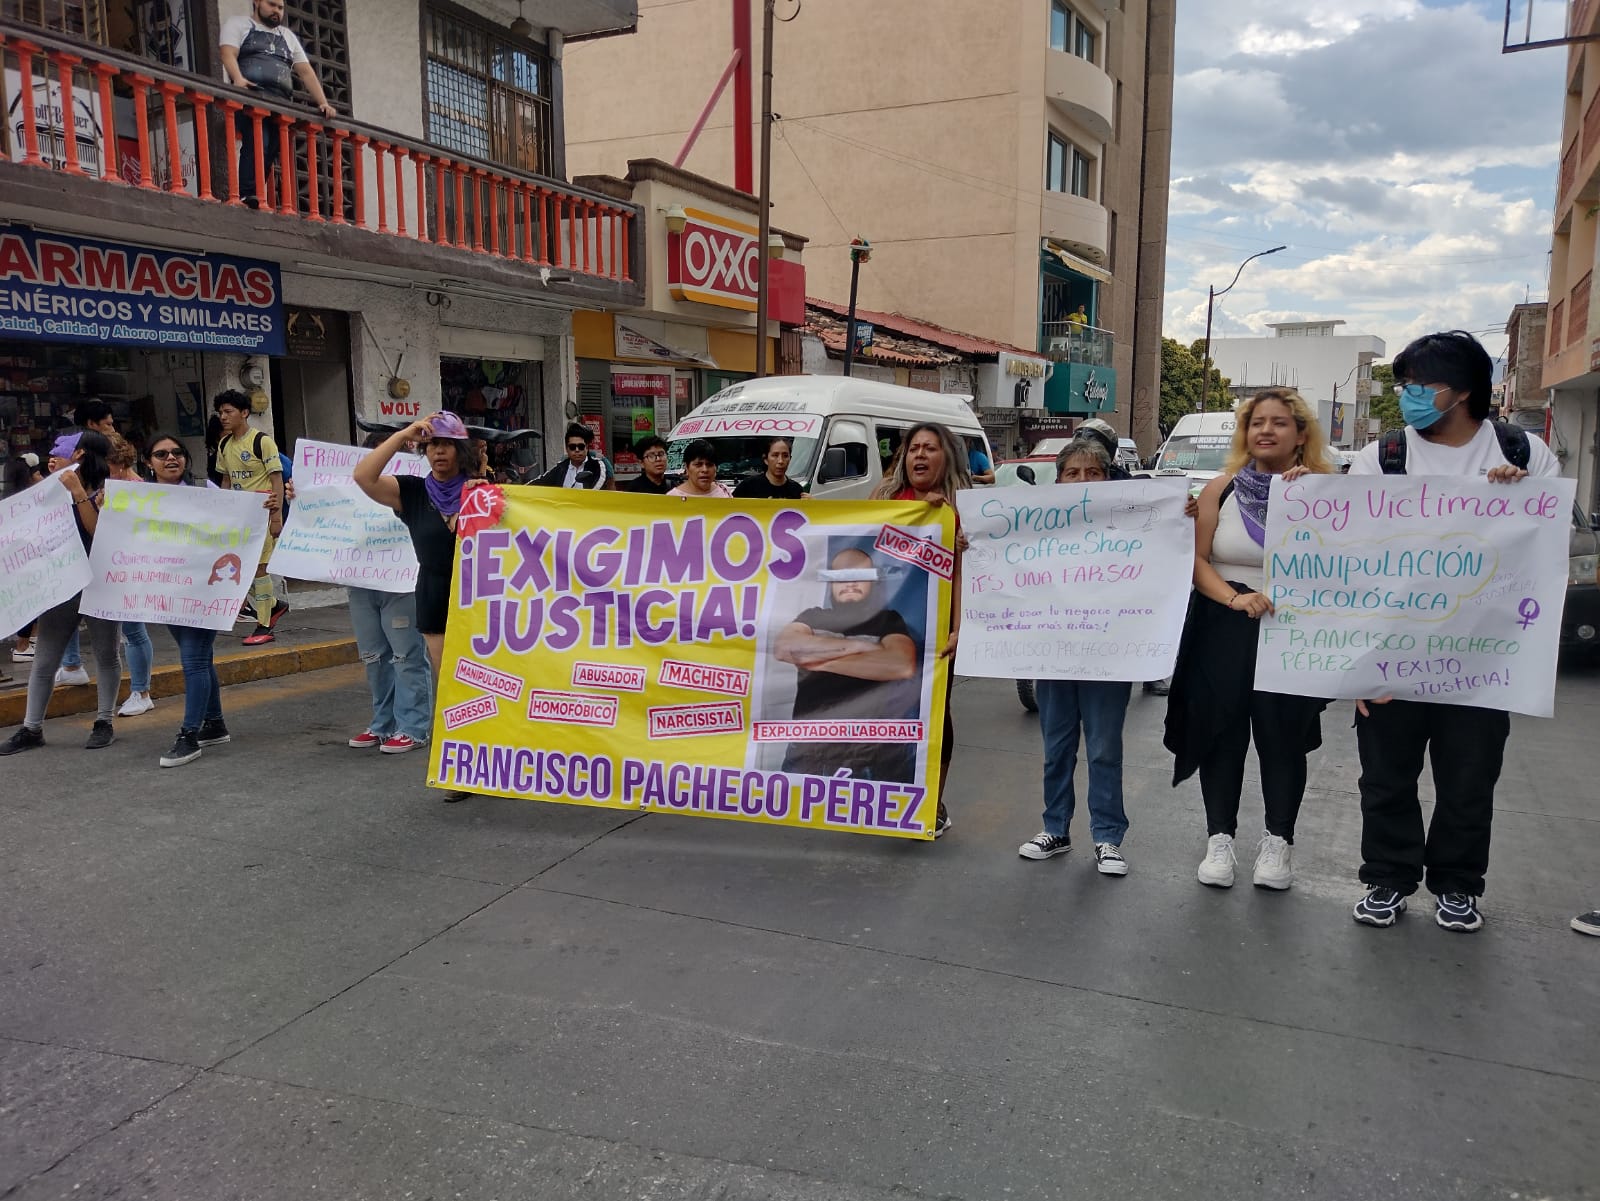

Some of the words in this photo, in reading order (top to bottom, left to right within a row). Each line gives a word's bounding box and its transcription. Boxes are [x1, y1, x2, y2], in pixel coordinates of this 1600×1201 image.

[138, 304, 152, 323] Y
[159, 306, 272, 332] SIMILARES
[44, 319, 98, 337] Calidad
[100, 326, 110, 340] y
[112, 324, 157, 341] Ahorro
[159, 330, 188, 345] para
[190, 331, 203, 344] tu
[204, 332, 264, 347] bienestar"
[380, 402, 420, 416] WOLF
[738, 402, 756, 412] DE
[755, 401, 808, 412] HUAUTLA
[704, 418, 816, 434] Liverpool
[231, 470, 253, 480] AT&T
[981, 488, 1093, 540] Smart
[1284, 484, 1350, 531] Soy
[1524, 491, 1559, 519] de
[1295, 530, 1310, 541] LA
[460, 510, 808, 606] ¡EXIGIMOS
[884, 536, 953, 571] VIOLADOR
[1272, 545, 1483, 585] MANIPULACIÓN
[329, 567, 417, 582] VIOLENCIA!
[1015, 570, 1052, 588] UNA
[1272, 584, 1448, 610] PSICOLÓGICA
[472, 584, 757, 657] JUSTICIA!
[1001, 608, 1015, 619] de
[1019, 610, 1042, 618] usar
[1049, 604, 1060, 616] tu
[1065, 606, 1111, 620] negocio
[1118, 607, 1153, 617] para
[1277, 611, 1297, 625] de
[1263, 627, 1416, 651] FRANCISCO
[1427, 635, 1520, 655] PACHECO
[1281, 649, 1356, 671] PÉREZ
[1376, 661, 1389, 681] Y
[1396, 657, 1462, 678] EXIJO
[458, 664, 519, 693] MANIPULADOR
[578, 668, 639, 686] ABUSADOR
[668, 666, 743, 690] MACHISTA
[1414, 667, 1510, 696] JUSTICIA!
[449, 701, 493, 725] AGRESOR
[532, 699, 613, 720] HOMOFÓBICO
[656, 711, 736, 729] NARCISISTA
[760, 724, 849, 738] EXPLOTADOR
[851, 724, 914, 739] LABORAL
[439, 741, 612, 801] FRANCISCO
[623, 759, 790, 816] PACHECO
[801, 768, 926, 831] PÉREZ
